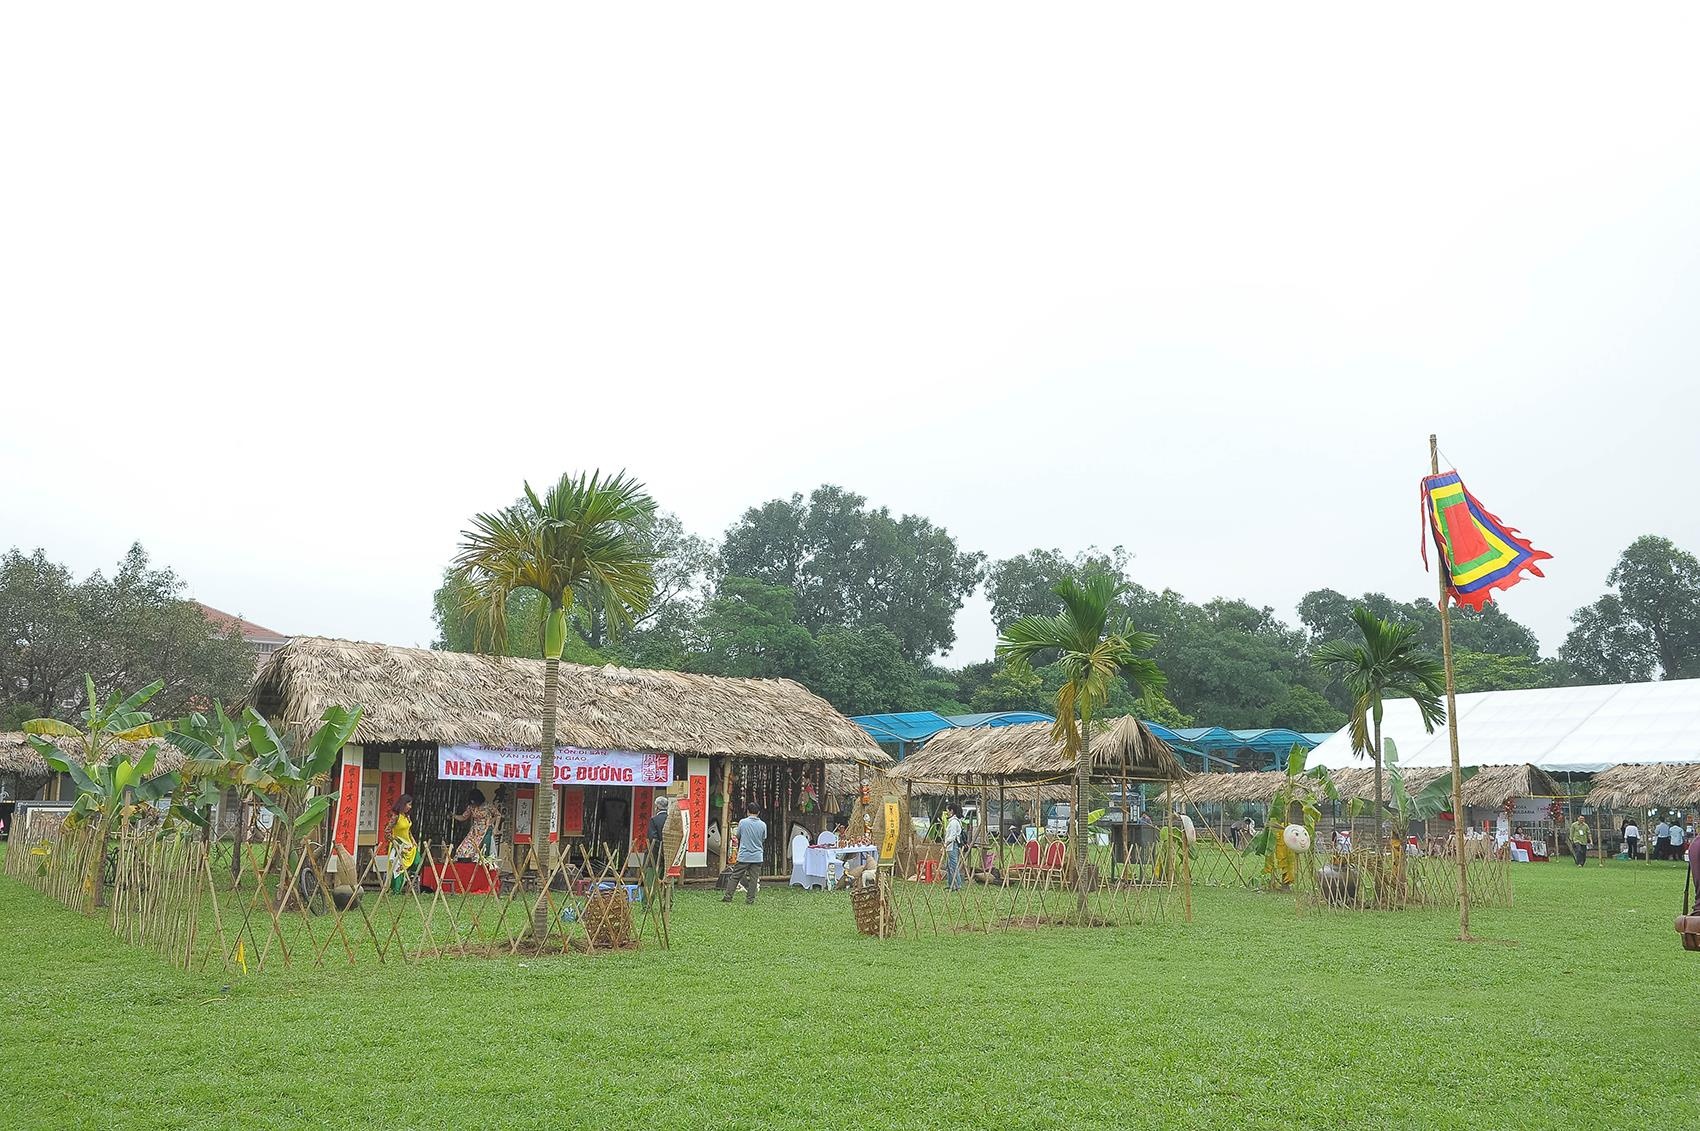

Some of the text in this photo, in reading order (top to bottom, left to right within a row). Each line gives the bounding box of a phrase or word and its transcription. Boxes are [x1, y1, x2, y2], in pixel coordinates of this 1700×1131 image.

[445, 759, 498, 778] NHÂN
[503, 761, 532, 779] MỸ
[576, 763, 633, 782] ĐƯỜNG
